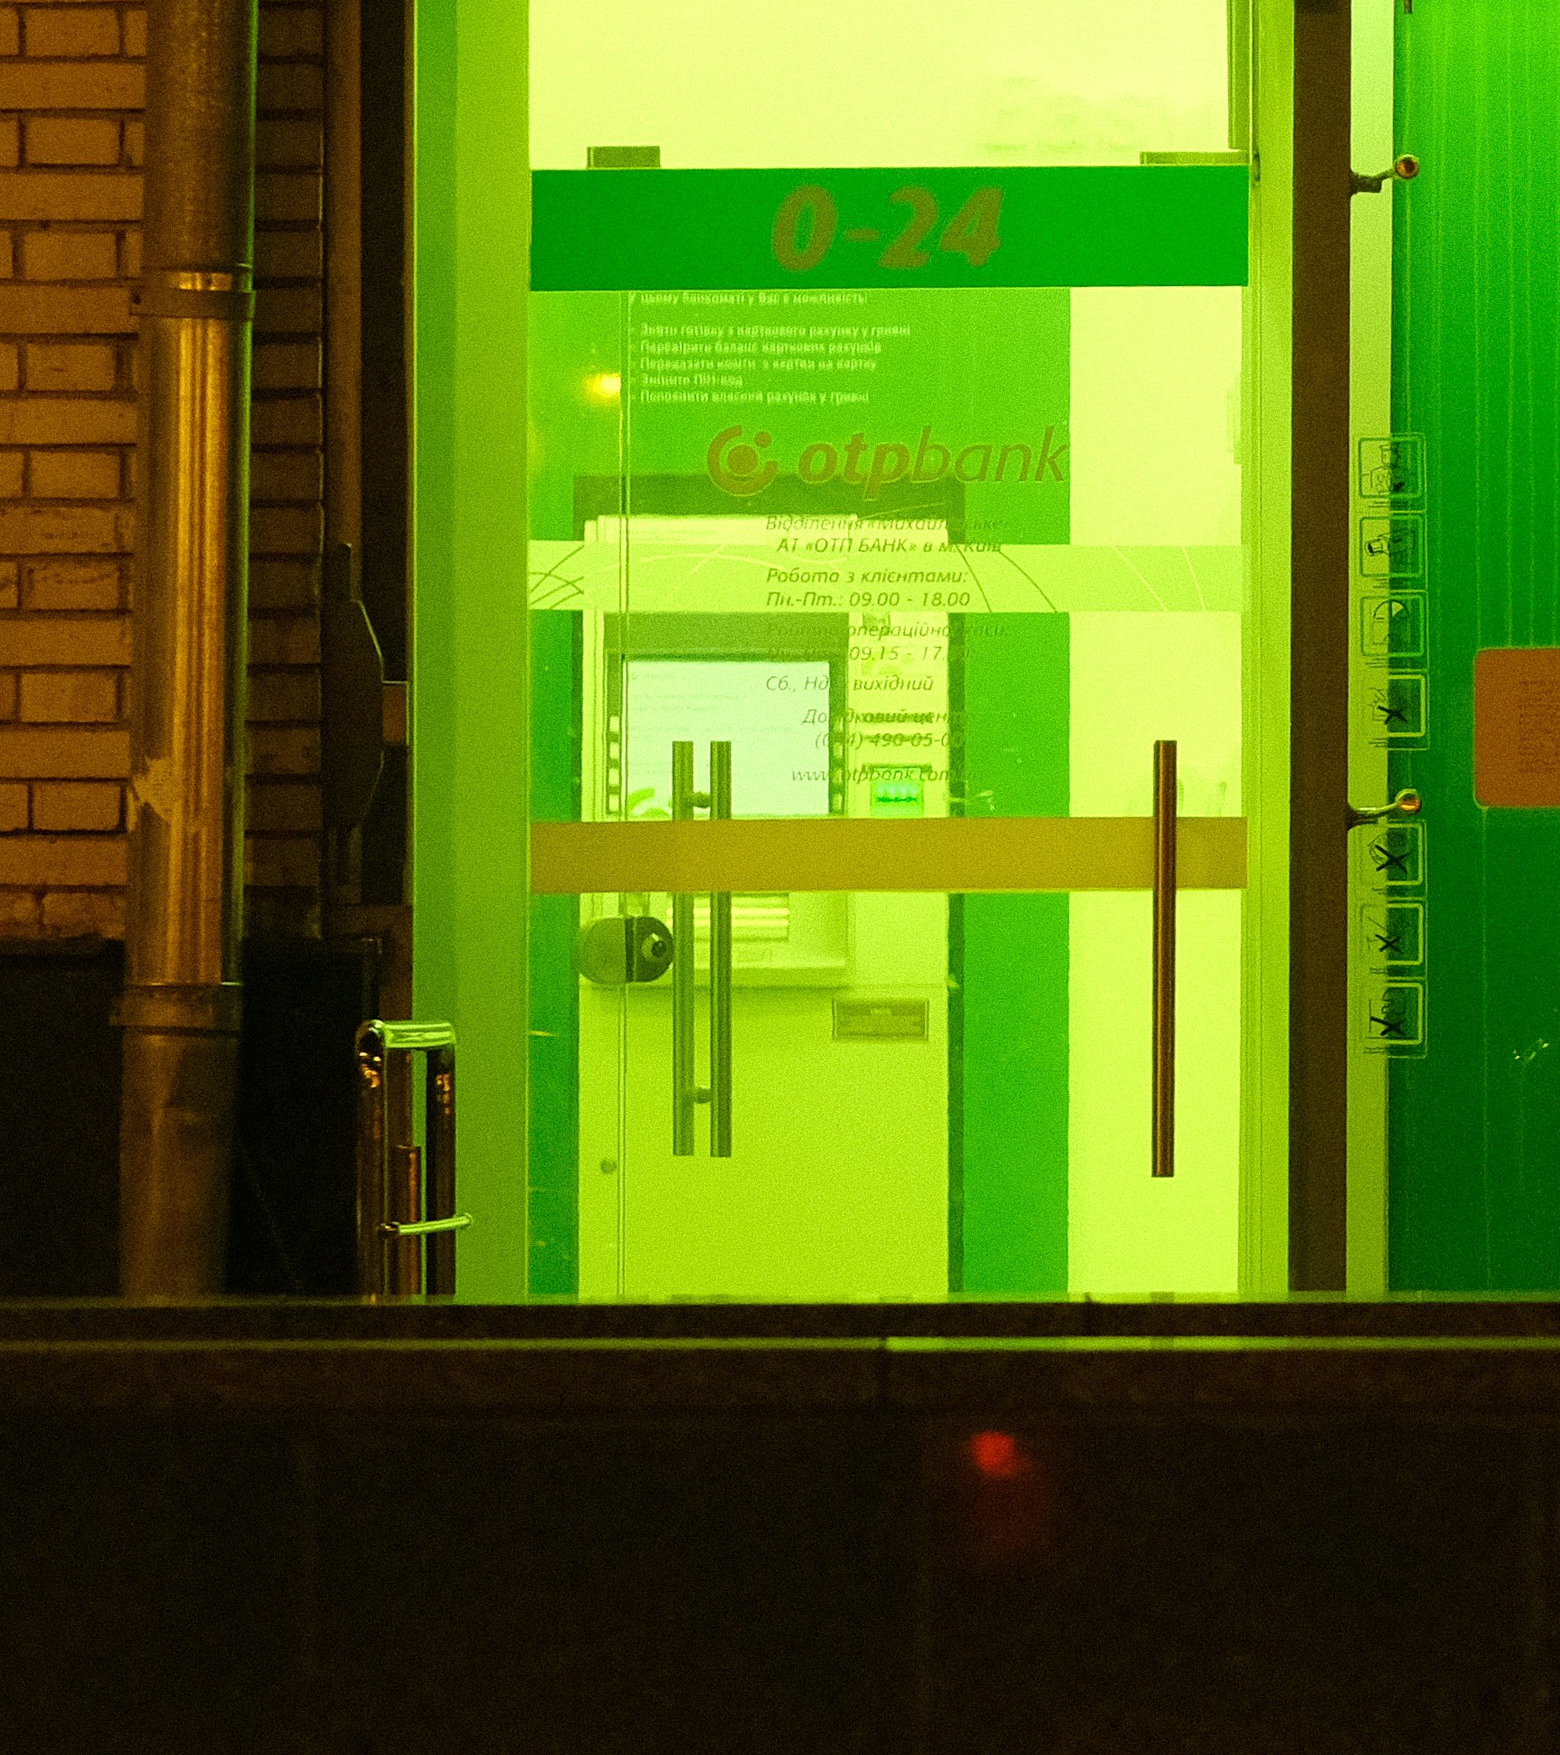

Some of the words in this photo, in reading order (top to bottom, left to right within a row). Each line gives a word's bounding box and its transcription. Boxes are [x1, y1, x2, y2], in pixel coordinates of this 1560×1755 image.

[772, 184, 1004, 272] 0-24
[800, 425, 1069, 501] otpbank
[777, 538, 798, 553] АТ
[805, 538, 852, 553] «ОТП
[858, 538, 918, 553] БАНК»
[766, 568, 840, 583] Робота
[847, 572, 856, 583] з
[861, 568, 968, 583] клієнтами:
[849, 591, 899, 606] 09.00
[922, 591, 970, 606] 18.00
[848, 621, 960, 641] операційно
[848, 645, 898, 660] 09.15
[766, 676, 797, 693] Сб.,
[853, 674, 934, 691] вихідний
